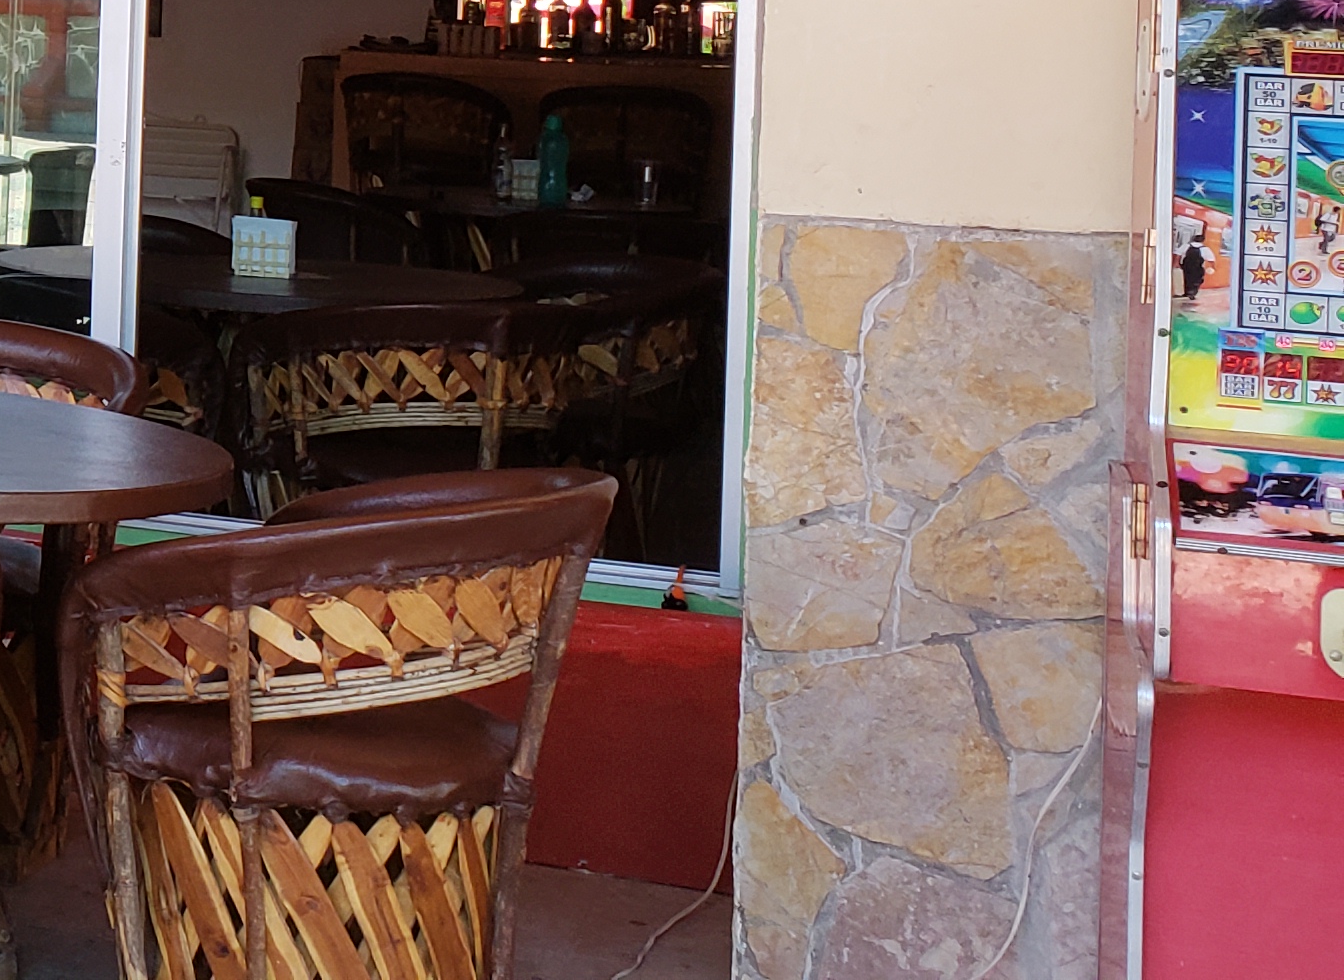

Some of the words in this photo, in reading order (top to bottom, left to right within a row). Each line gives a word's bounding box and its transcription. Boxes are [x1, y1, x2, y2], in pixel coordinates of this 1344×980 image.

[1256, 81, 1283, 90] BAR
[1256, 99, 1282, 107] BAR
[1297, 268, 1312, 281] 2
[1250, 297, 1277, 306] BAR
[1250, 313, 1277, 322] BAR
[1267, 380, 1298, 399] 77
